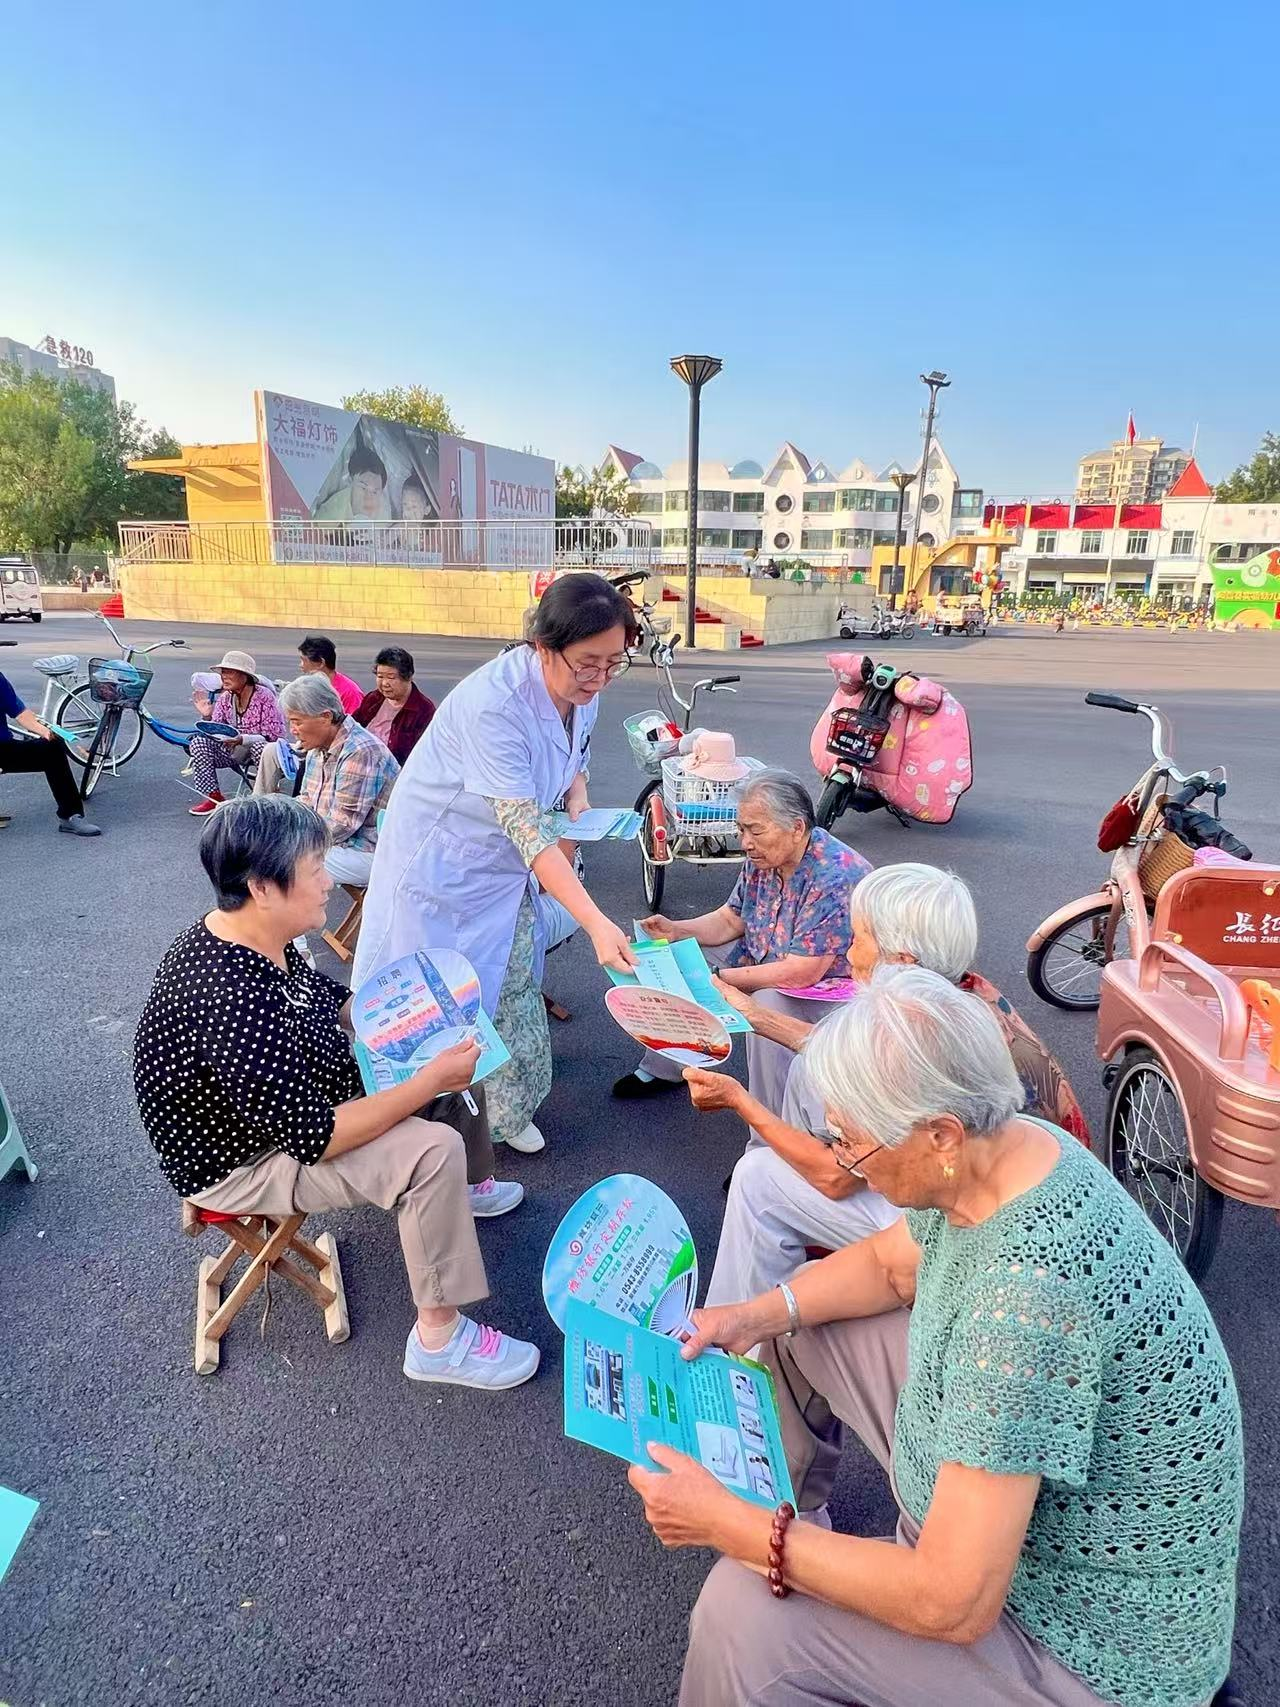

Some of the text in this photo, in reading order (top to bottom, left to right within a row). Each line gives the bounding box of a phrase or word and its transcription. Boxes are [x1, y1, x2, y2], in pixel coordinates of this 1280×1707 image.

[46, 335, 94, 366] 急救120
[272, 413, 338, 445] 大福灯饰
[489, 479, 551, 513] TATA木门
[1222, 935, 1257, 943] CHANG
[377, 968, 402, 988] 招聘
